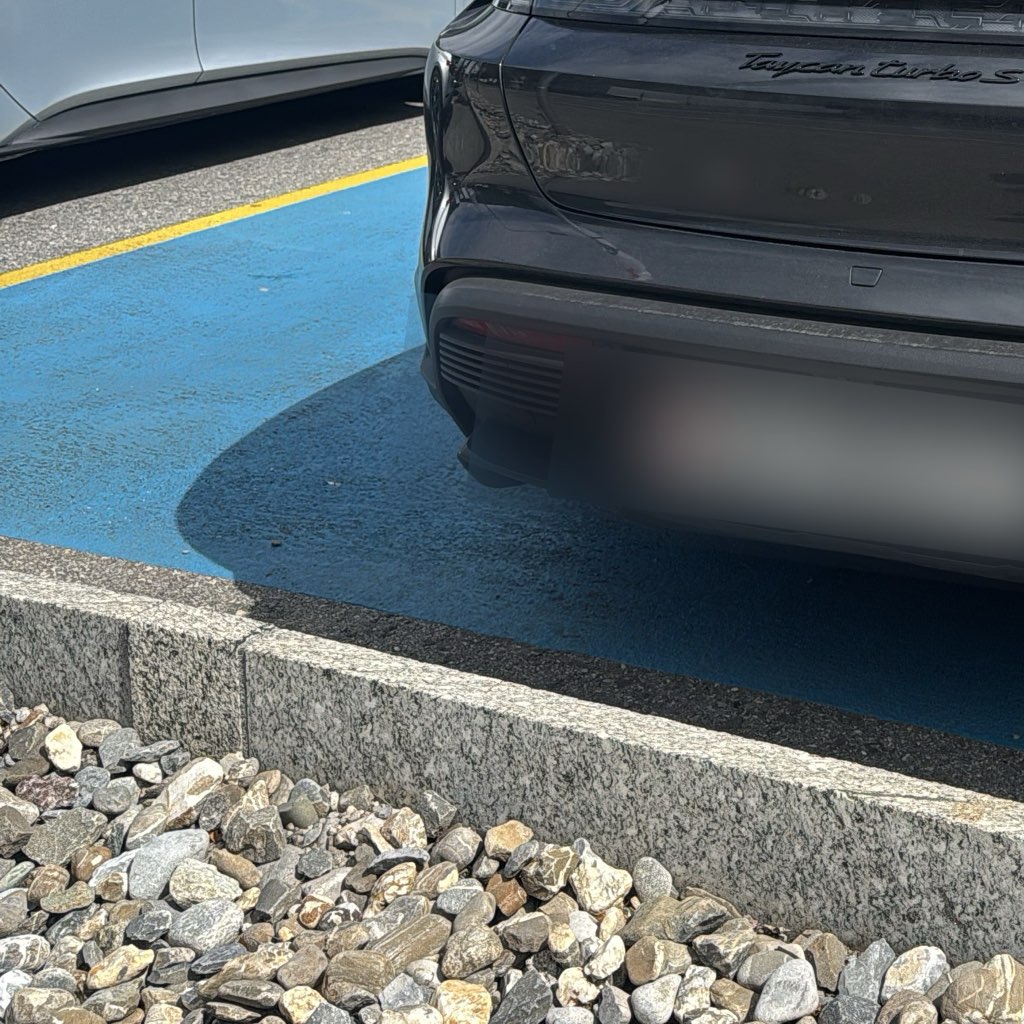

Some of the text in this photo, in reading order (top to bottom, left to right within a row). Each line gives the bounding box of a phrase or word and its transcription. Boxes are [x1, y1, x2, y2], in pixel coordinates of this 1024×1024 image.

[738, 52, 1024, 85] Taycan turbo S
